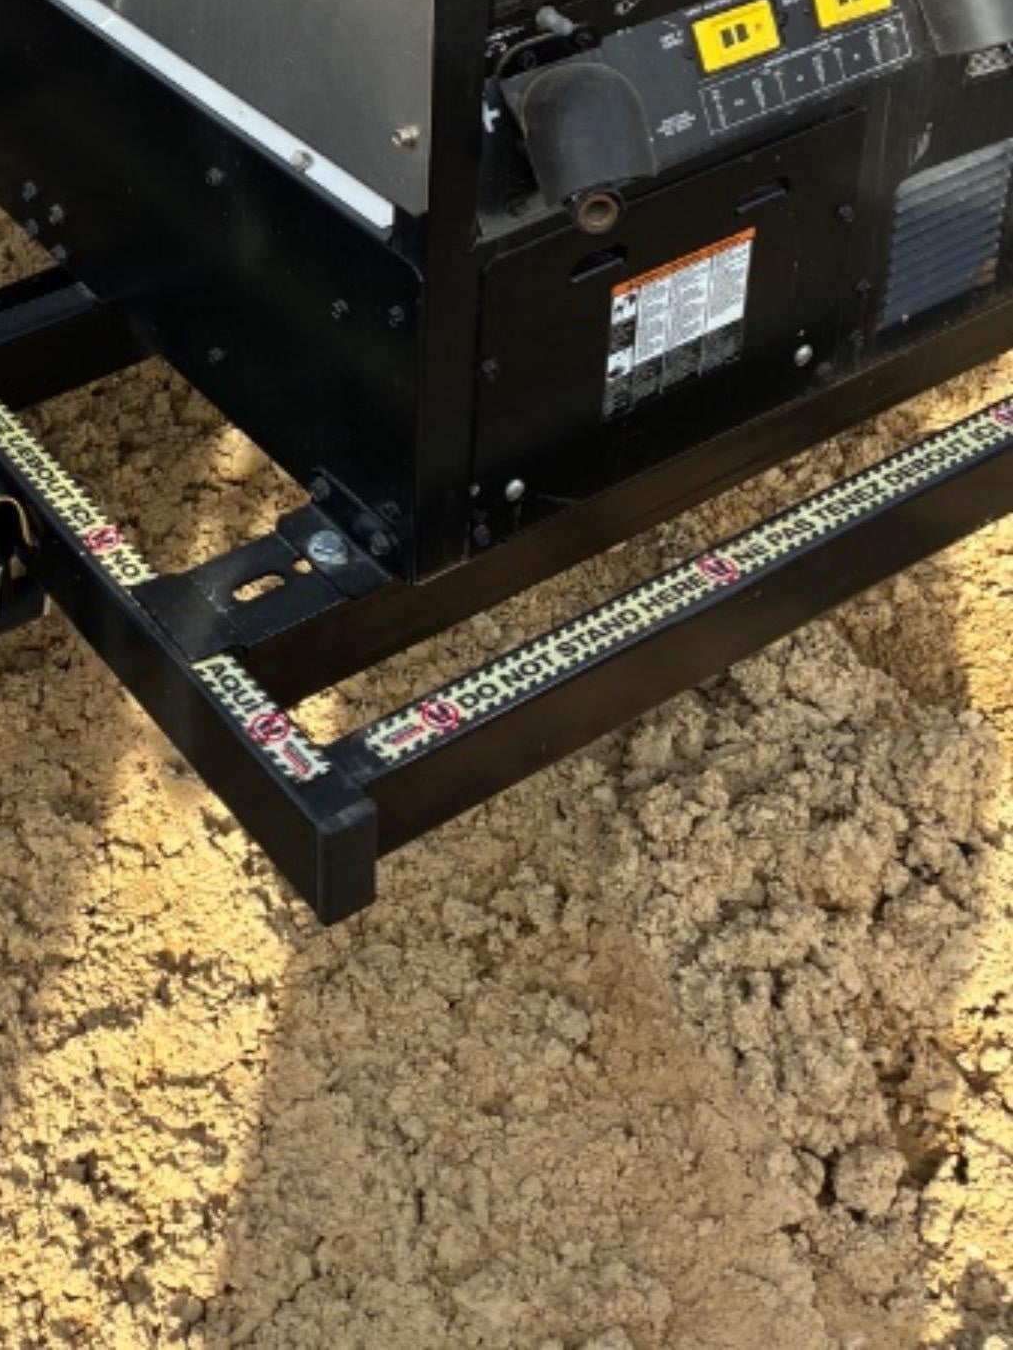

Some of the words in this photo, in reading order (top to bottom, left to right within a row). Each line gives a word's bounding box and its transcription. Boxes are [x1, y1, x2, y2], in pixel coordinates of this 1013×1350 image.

[731, 541, 766, 565] NE
[765, 518, 816, 548] PAS
[810, 481, 886, 517] TENEZ
[883, 436, 969, 486] DEBOUT
[108, 548, 139, 578] NO
[459, 682, 499, 709] DO
[500, 651, 554, 687] NOT
[555, 607, 641, 660] STAND
[639, 575, 708, 613] HERE
[207, 663, 262, 715] AQUI
